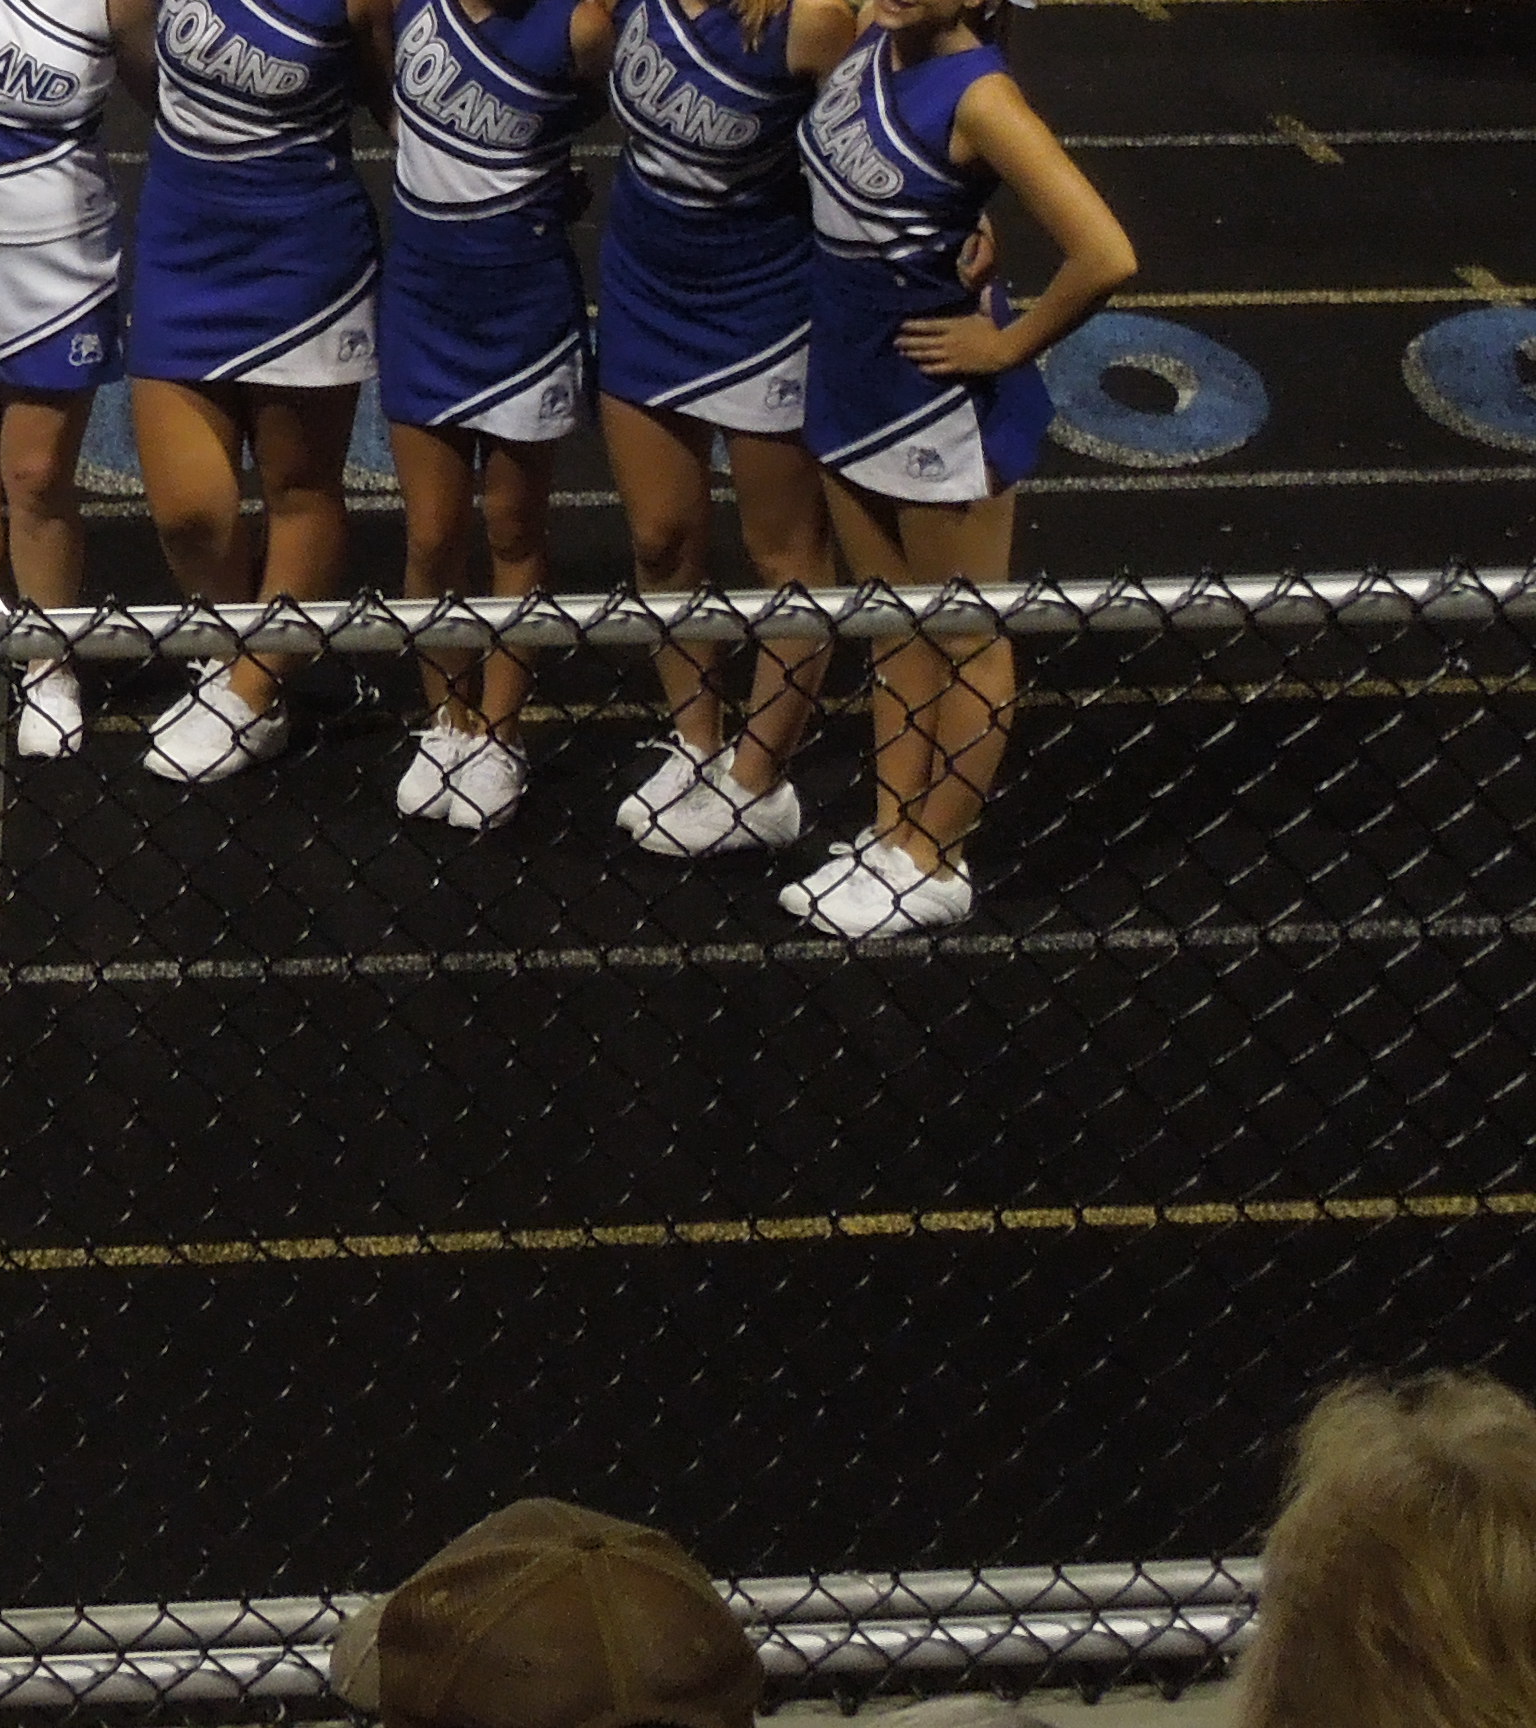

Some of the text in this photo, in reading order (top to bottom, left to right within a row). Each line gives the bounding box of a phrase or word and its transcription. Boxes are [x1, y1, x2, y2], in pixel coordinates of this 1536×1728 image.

[395, 1, 542, 146] POLAND
[615, 0, 760, 149] POLAND
[810, 44, 904, 200] POLAND
